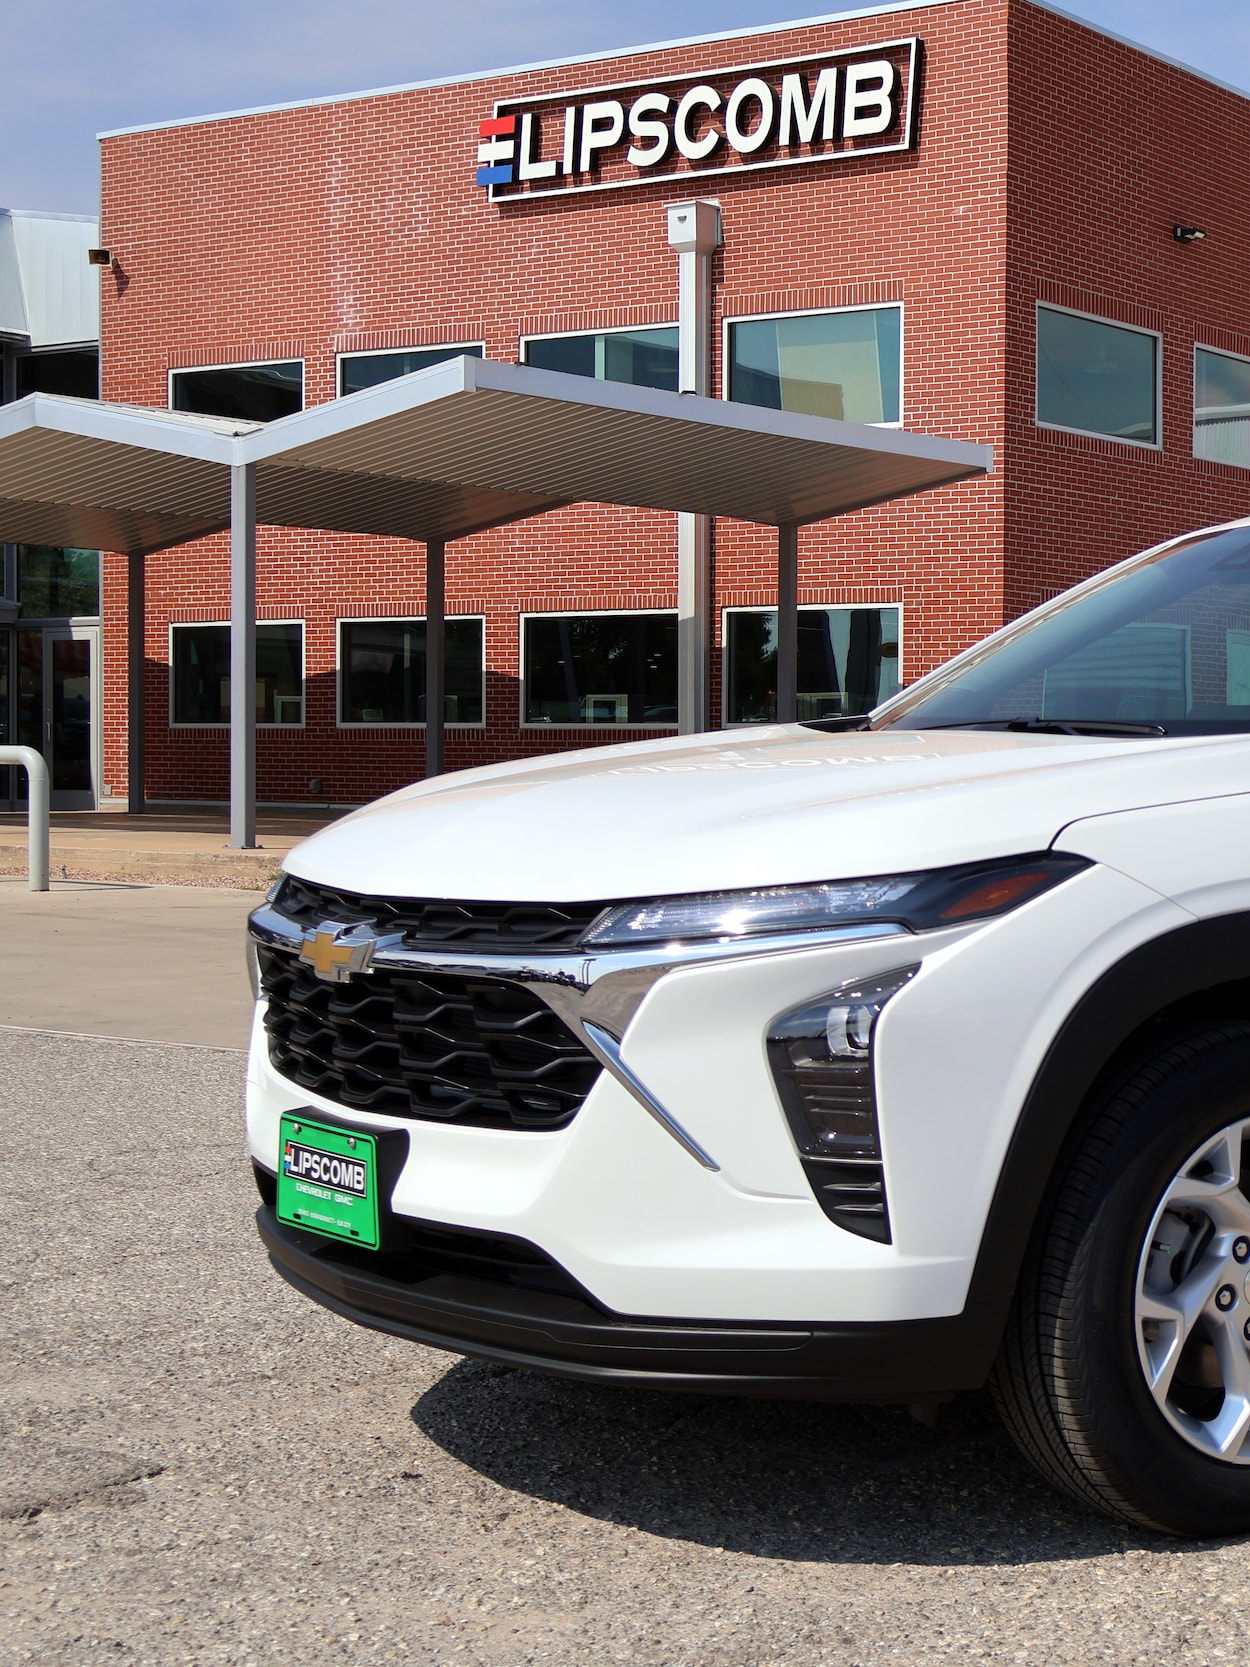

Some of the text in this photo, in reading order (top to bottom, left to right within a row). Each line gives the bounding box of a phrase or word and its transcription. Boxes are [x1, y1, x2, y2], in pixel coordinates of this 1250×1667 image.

[518, 59, 895, 181] LIPSCOMB
[290, 1147, 365, 1190] LIPSCOMB
[295, 1182, 332, 1201] CHEVROLET
